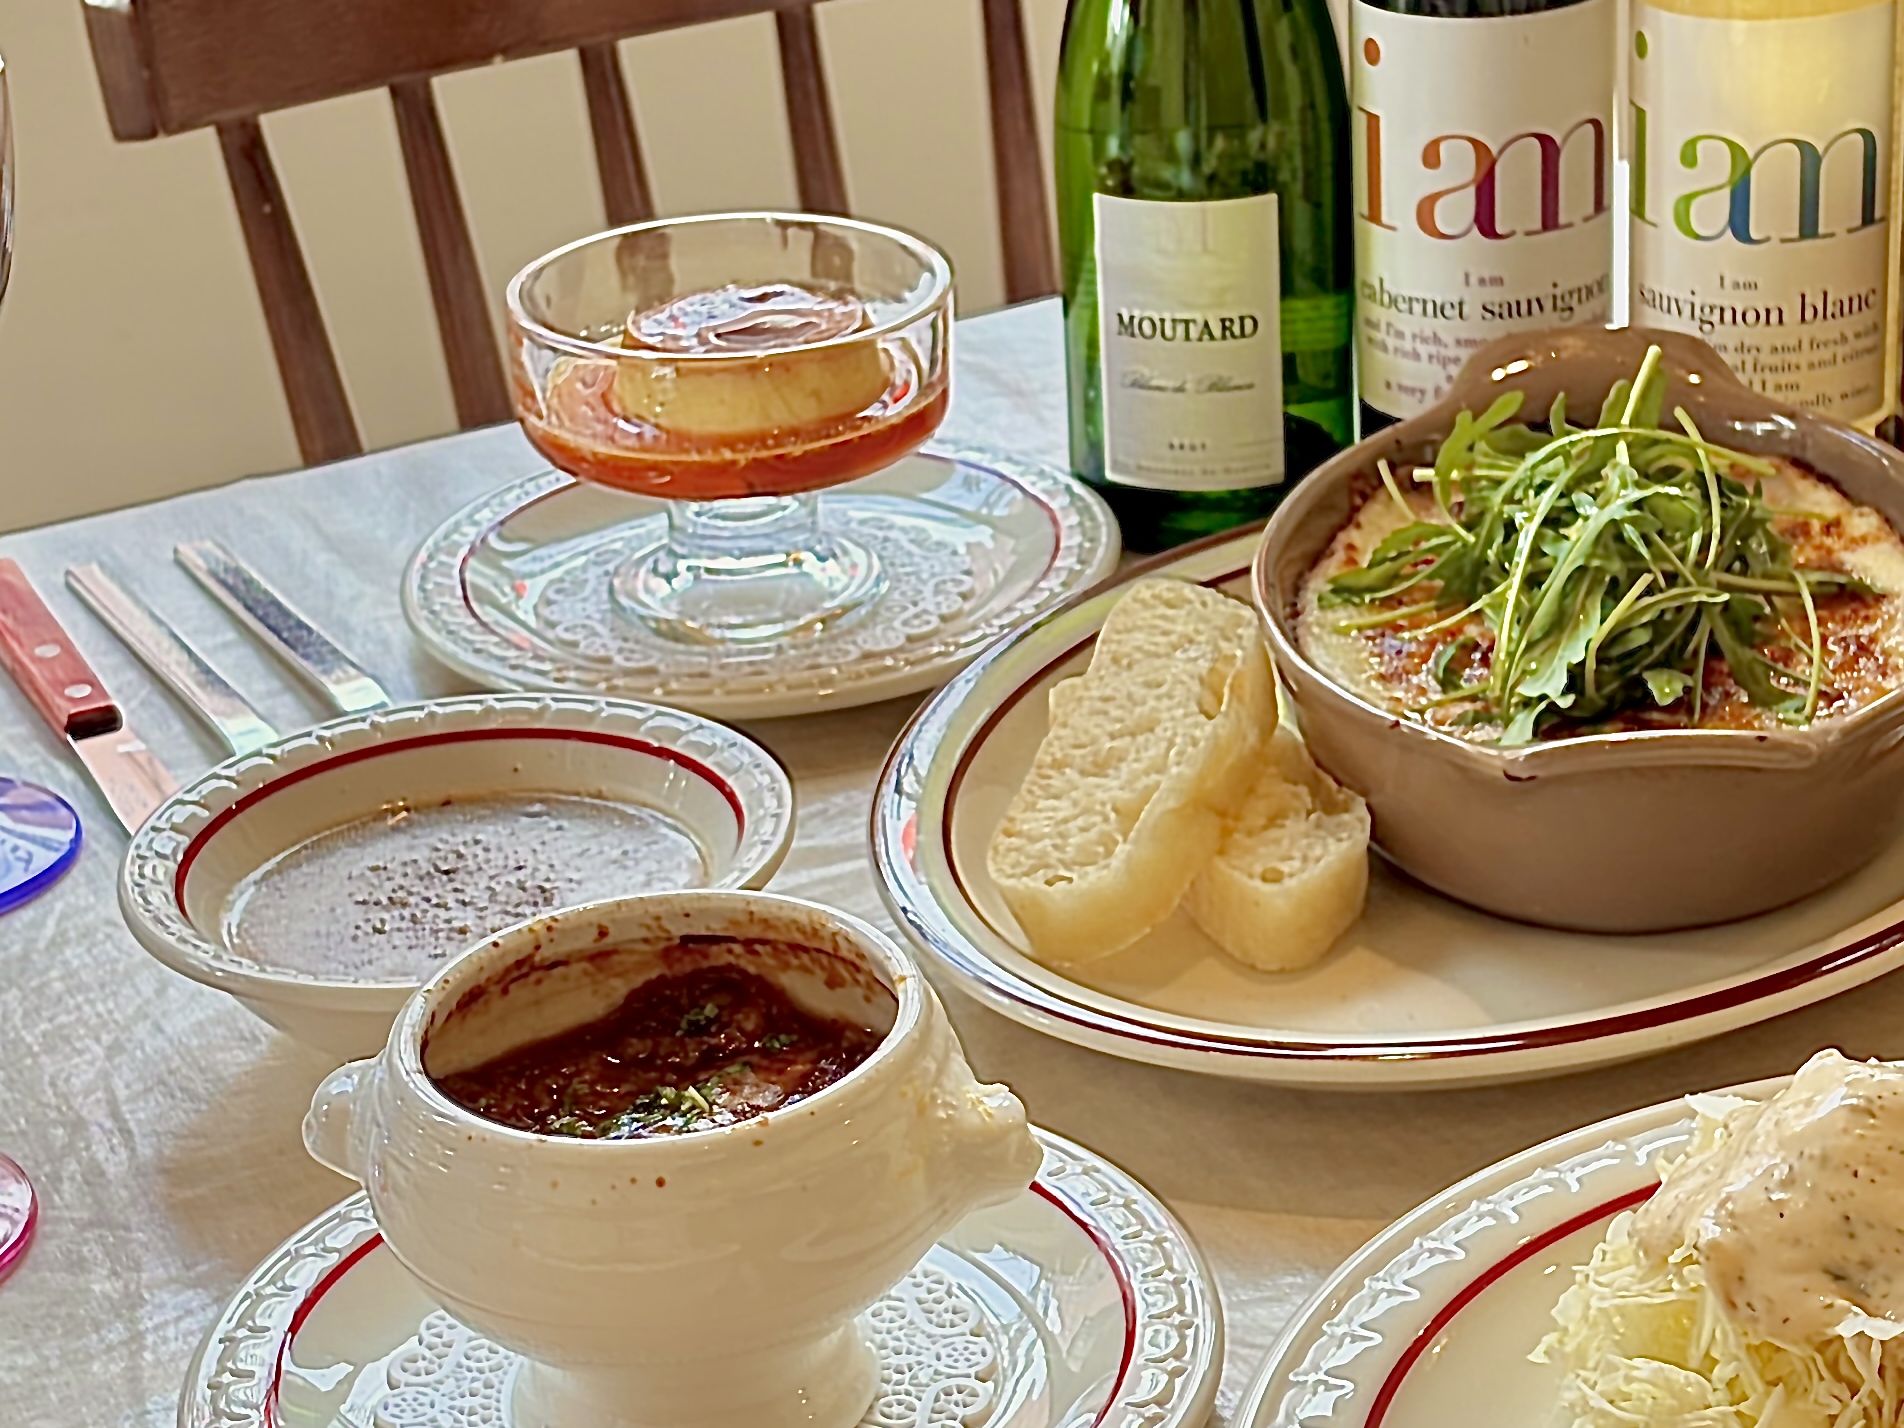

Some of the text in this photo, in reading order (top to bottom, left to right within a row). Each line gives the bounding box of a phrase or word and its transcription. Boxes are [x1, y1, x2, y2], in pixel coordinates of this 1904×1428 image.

[1415, 117, 1612, 241] am
[1672, 127, 1887, 245] am
[1360, 276, 1468, 321] cabernet
[1478, 276, 1505, 289] am
[1731, 277, 1759, 291] am
[1116, 312, 1260, 343] MOUTARD
[1639, 283, 1877, 335] sauvignon blanc
